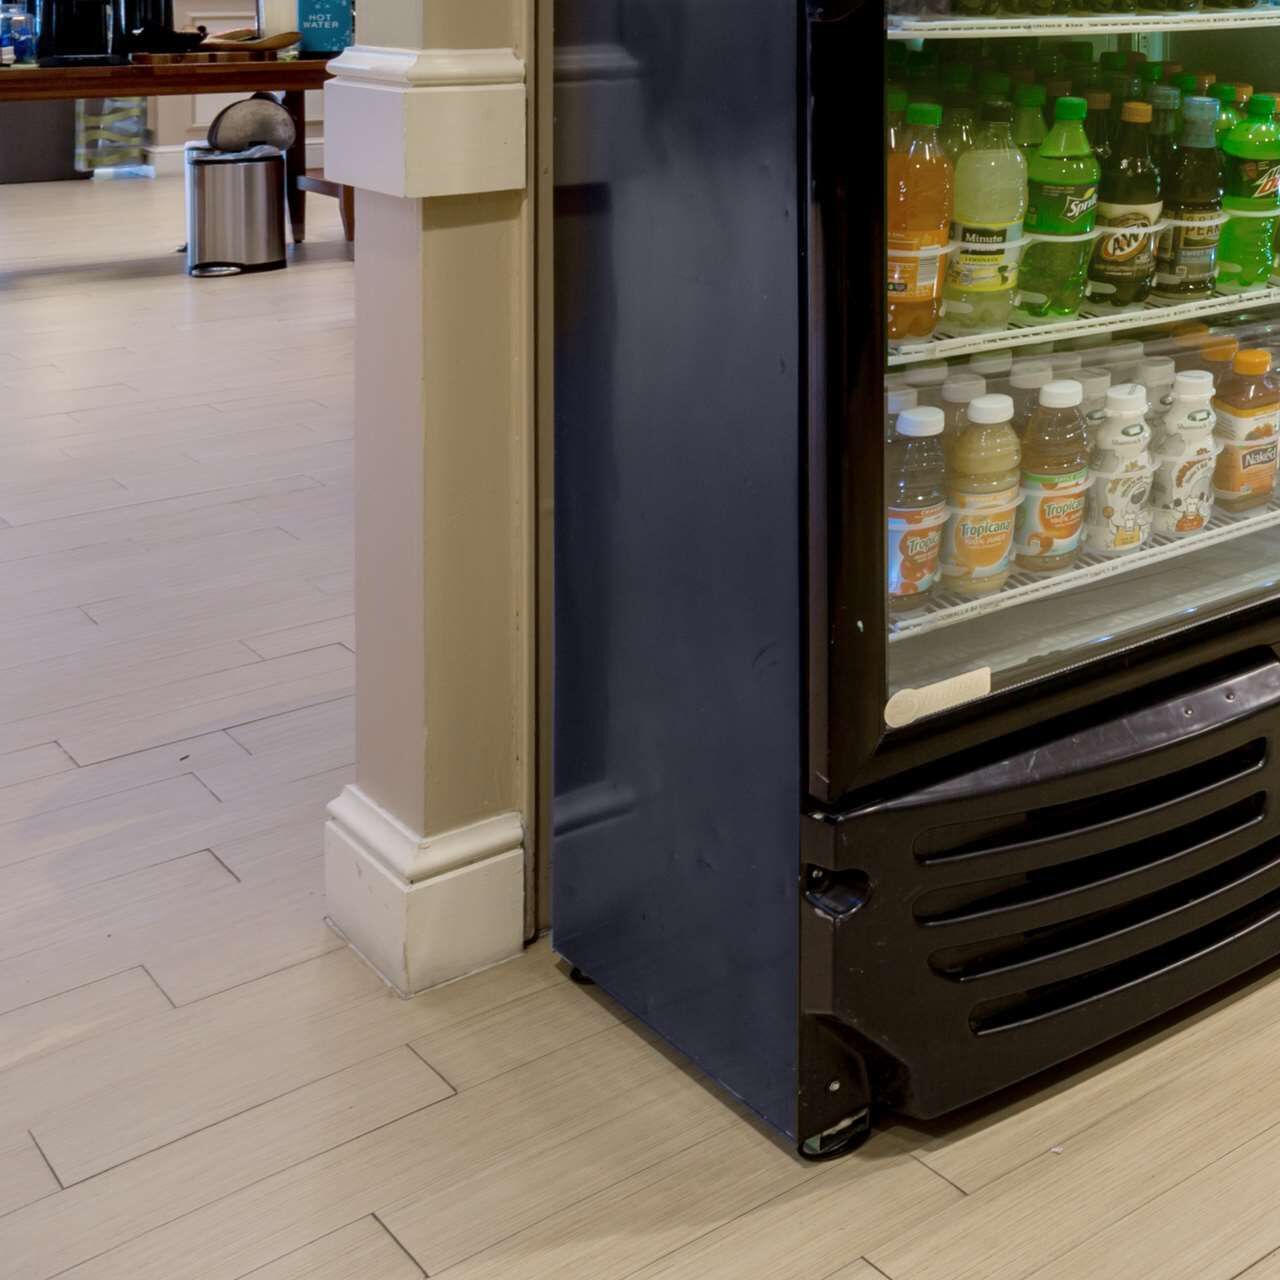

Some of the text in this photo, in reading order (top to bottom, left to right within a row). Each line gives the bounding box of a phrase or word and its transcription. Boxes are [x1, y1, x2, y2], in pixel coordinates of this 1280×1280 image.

[303, 21, 339, 29] WATER
[965, 233, 1004, 243] Minute
[1245, 445, 1277, 468] Naked
[960, 522, 1011, 537] Tropicana
